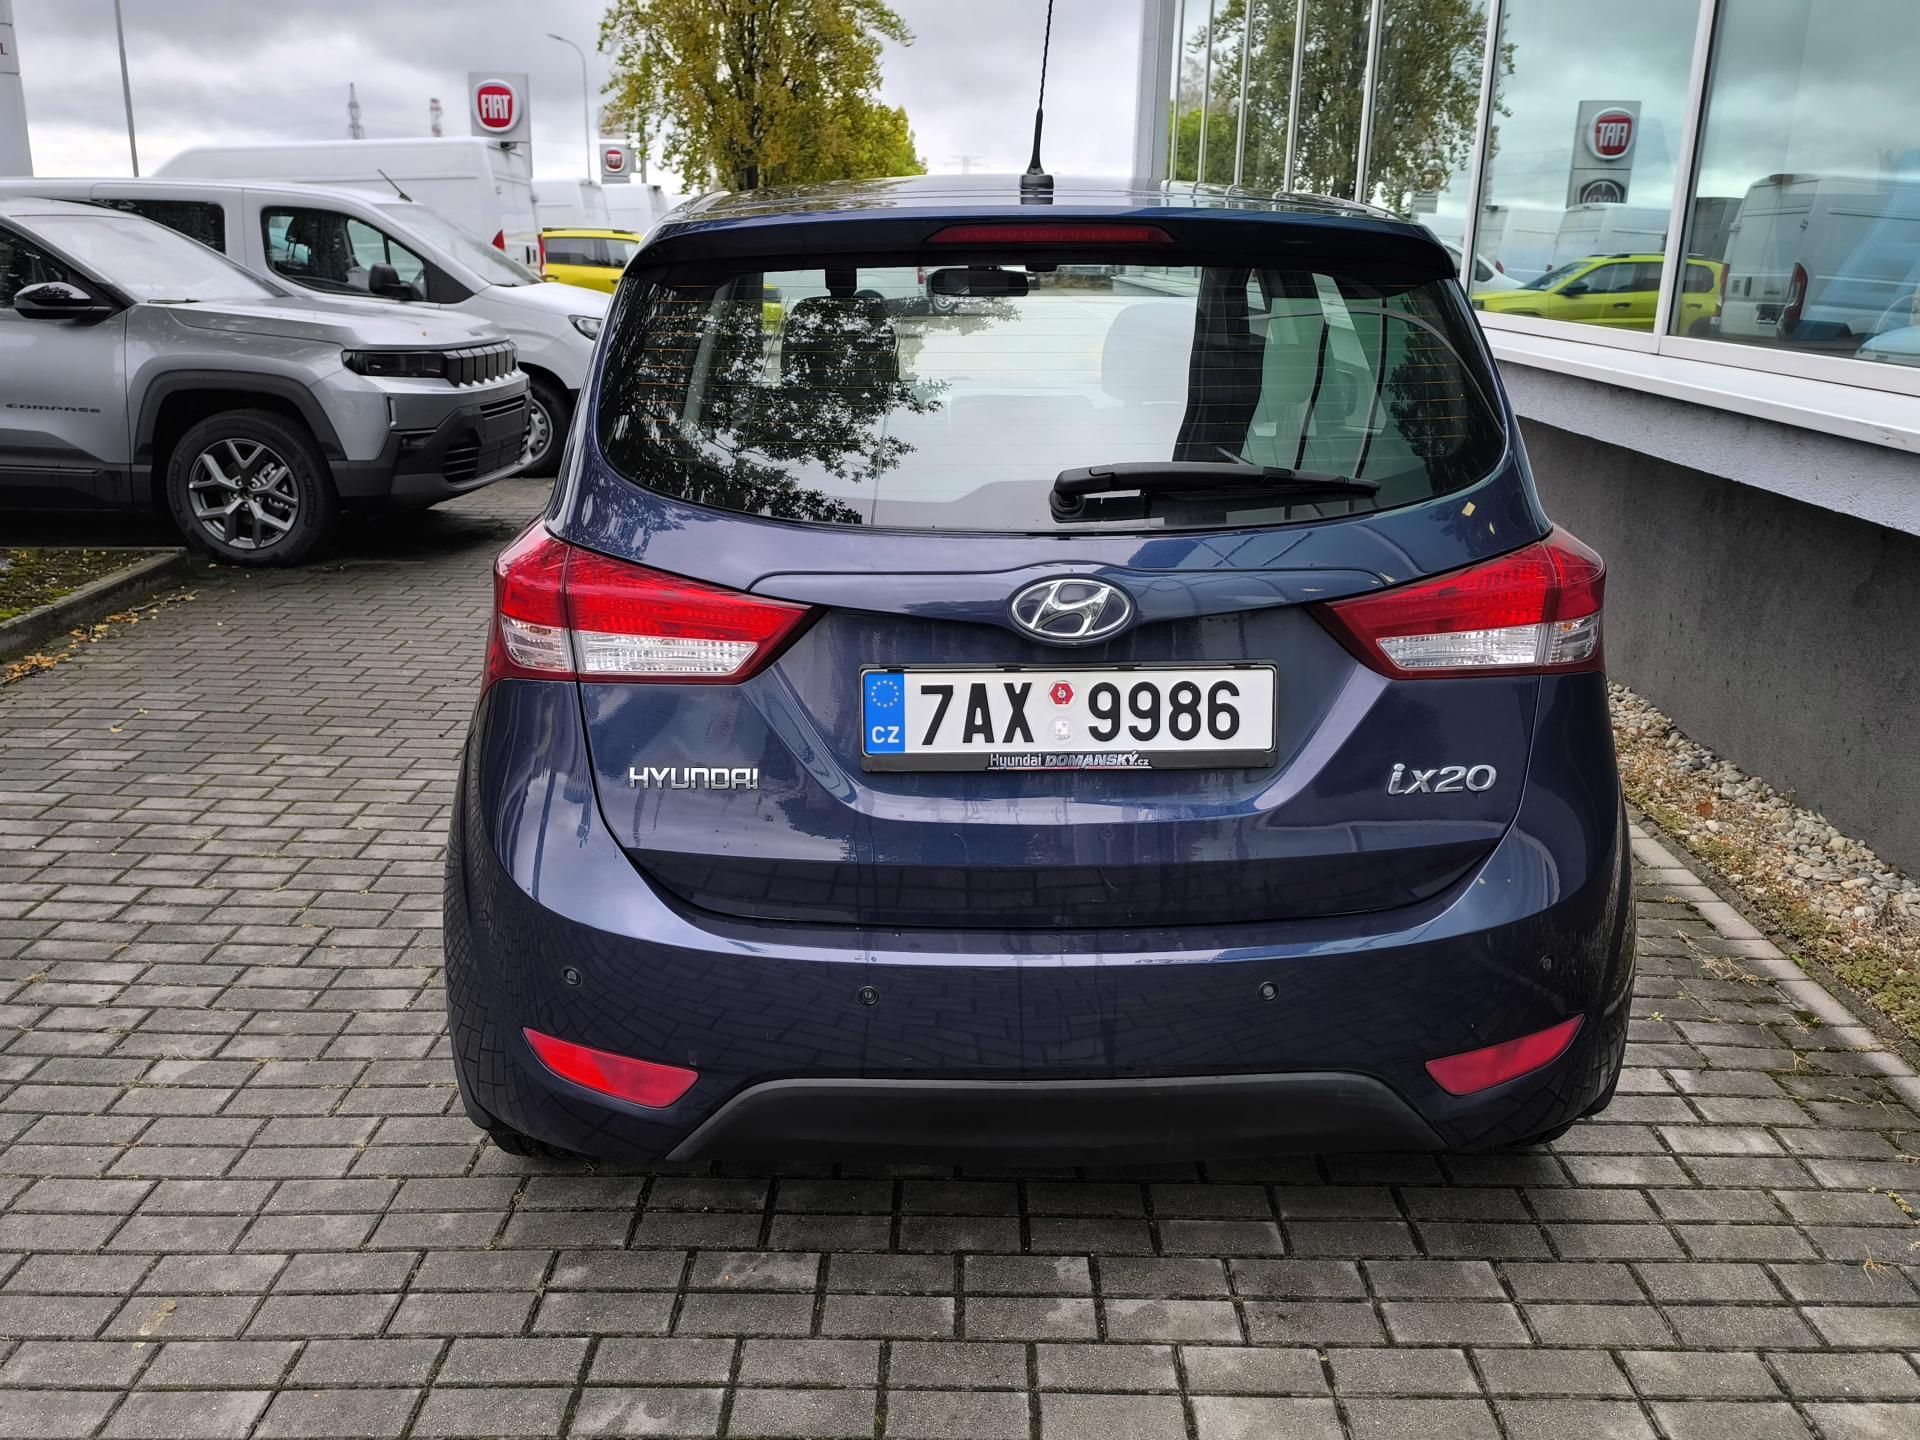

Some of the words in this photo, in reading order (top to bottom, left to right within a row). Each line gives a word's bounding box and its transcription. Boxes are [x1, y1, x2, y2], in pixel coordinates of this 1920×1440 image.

[480, 94, 510, 119] FIAT
[920, 681, 1034, 746] 7AX
[1088, 679, 1240, 743] 9986
[871, 726, 900, 744] CZ
[990, 753, 1042, 769] Hyundai
[629, 767, 759, 790] HYUNDAI
[1387, 763, 1498, 795] ix20
